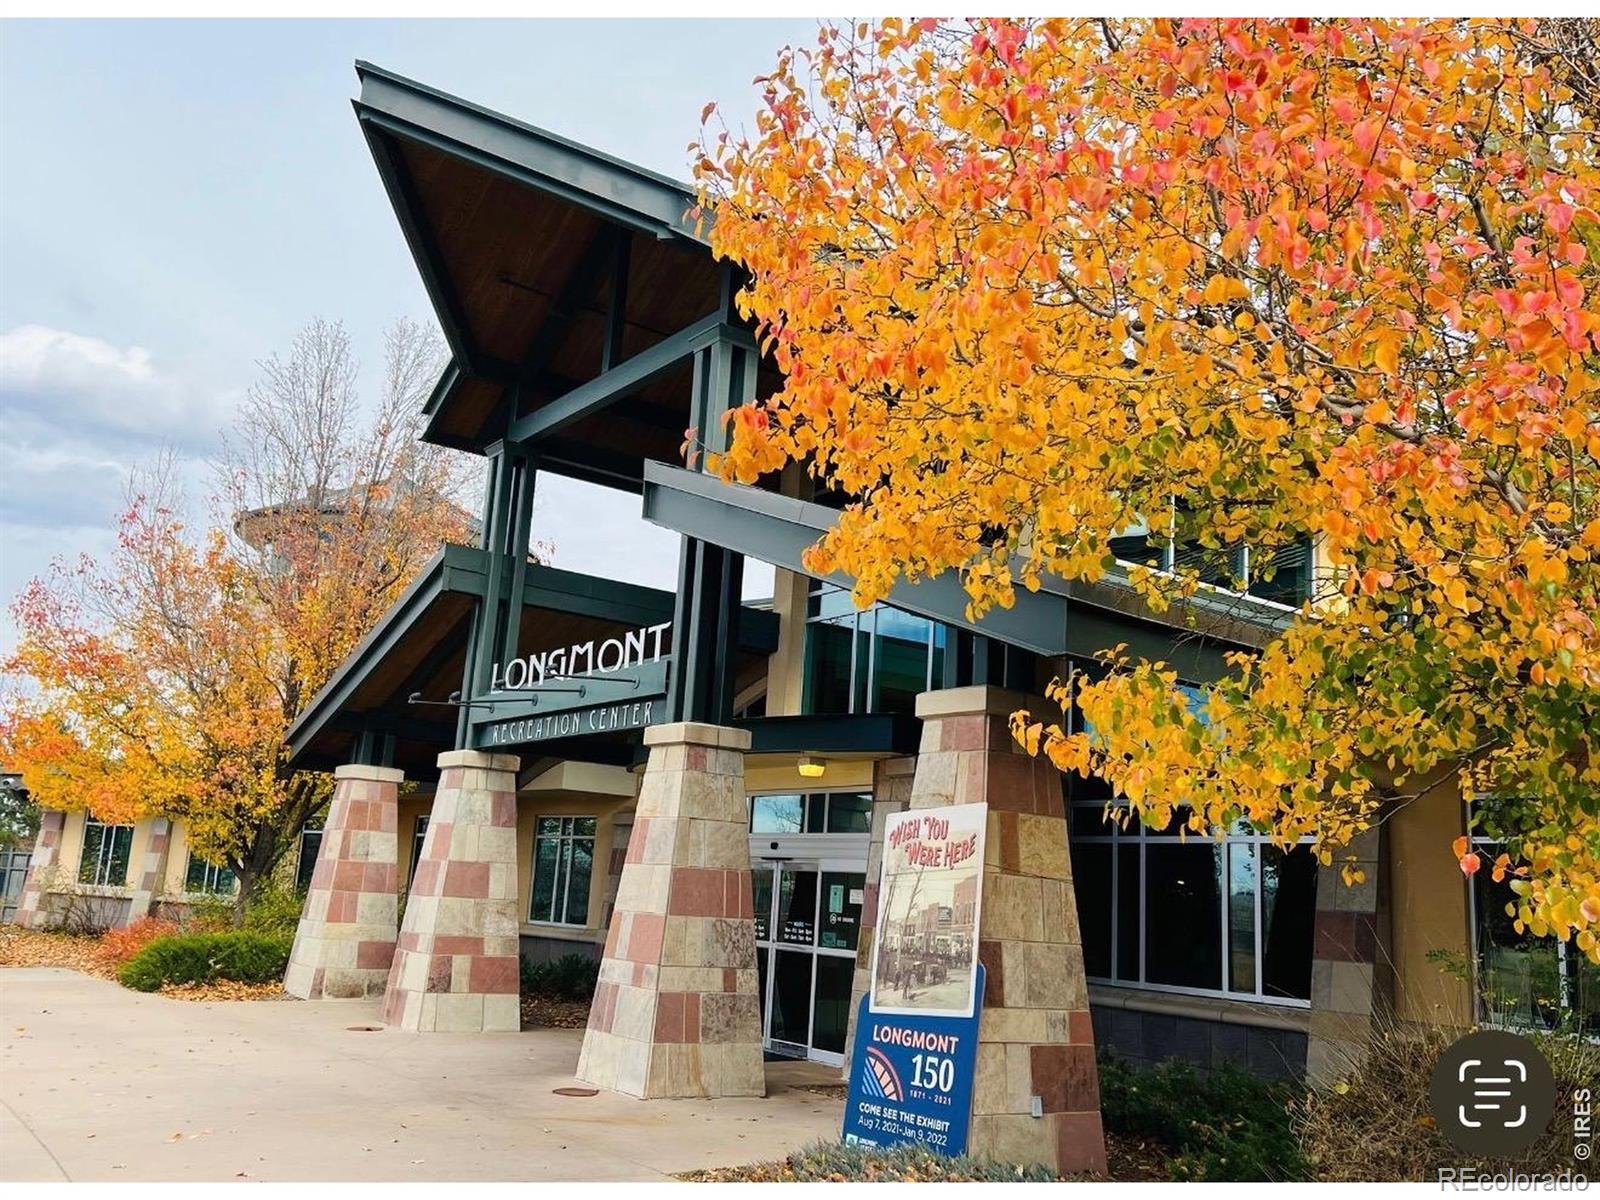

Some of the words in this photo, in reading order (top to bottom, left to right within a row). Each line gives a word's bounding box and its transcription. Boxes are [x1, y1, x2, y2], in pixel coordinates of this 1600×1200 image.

[491, 621, 672, 694] LONGMONT
[492, 711, 581, 743] RECREATION
[590, 701, 653, 730] CENTER
[889, 819, 920, 849] WISH
[924, 816, 949, 840] YOU
[905, 842, 942, 867] WERE
[944, 833, 977, 870] HERE
[873, 1024, 959, 1054] LONGMONT
[910, 1054, 955, 1092] 150
[858, 1115, 874, 1129] Aug
[926, 1131, 948, 1146] 2022
[859, 1102, 881, 1116] COME
[882, 1107, 898, 1120] SEE
[899, 1111, 916, 1124] THE
[916, 1115, 950, 1132] EXHIBIT
